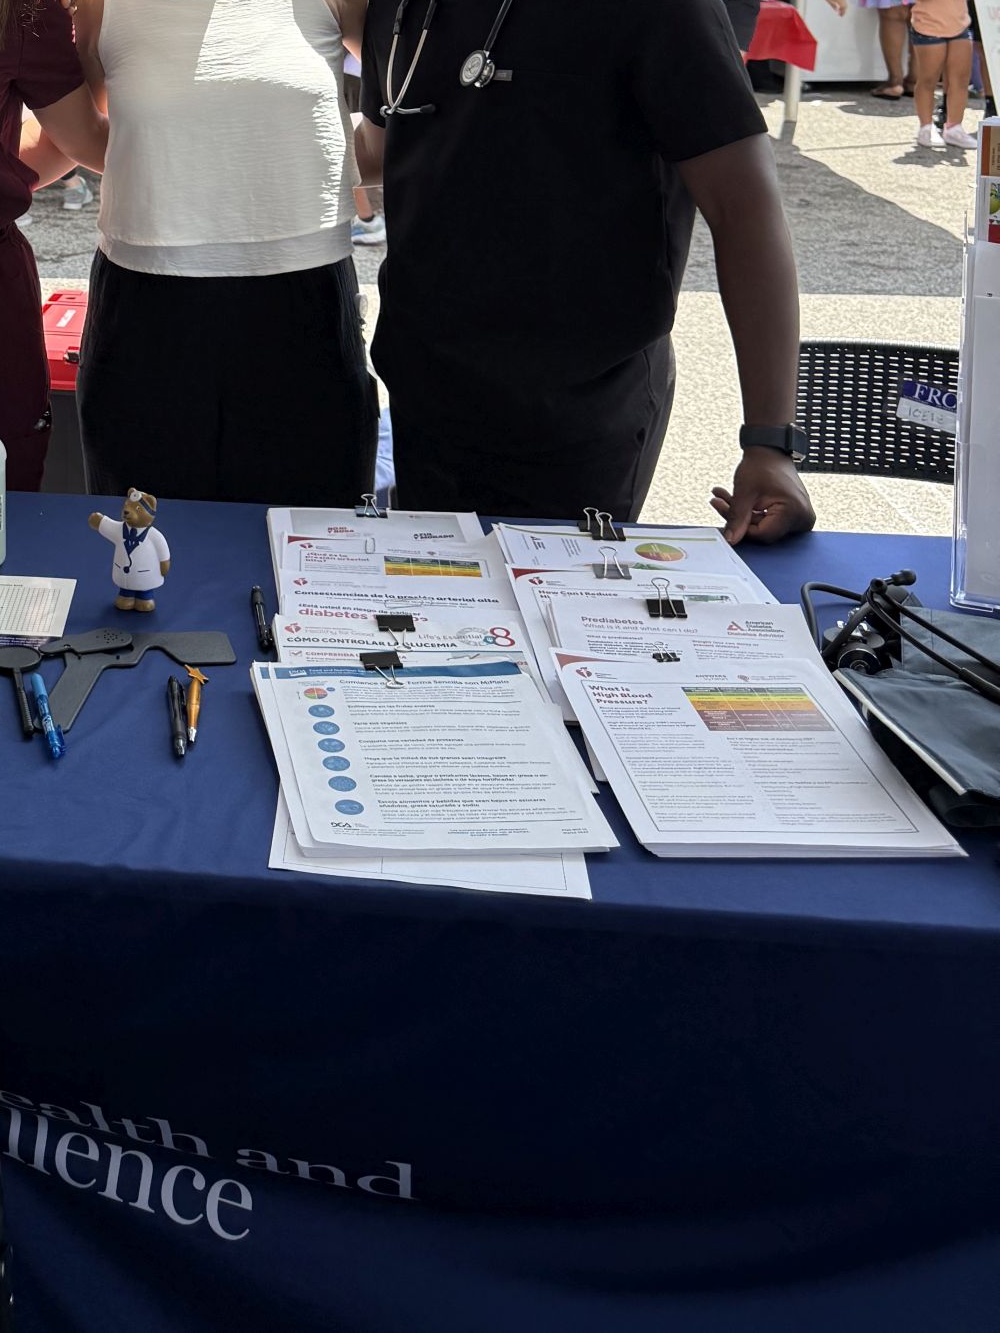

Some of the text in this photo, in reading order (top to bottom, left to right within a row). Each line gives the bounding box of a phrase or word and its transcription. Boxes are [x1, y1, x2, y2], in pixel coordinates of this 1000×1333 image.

[298, 608, 368, 620] diabetes
[581, 616, 644, 625] Prediabetes
[322, 638, 385, 646] CONTROLAR
[490, 627, 515, 647] 8
[236, 1146, 420, 1200] and
